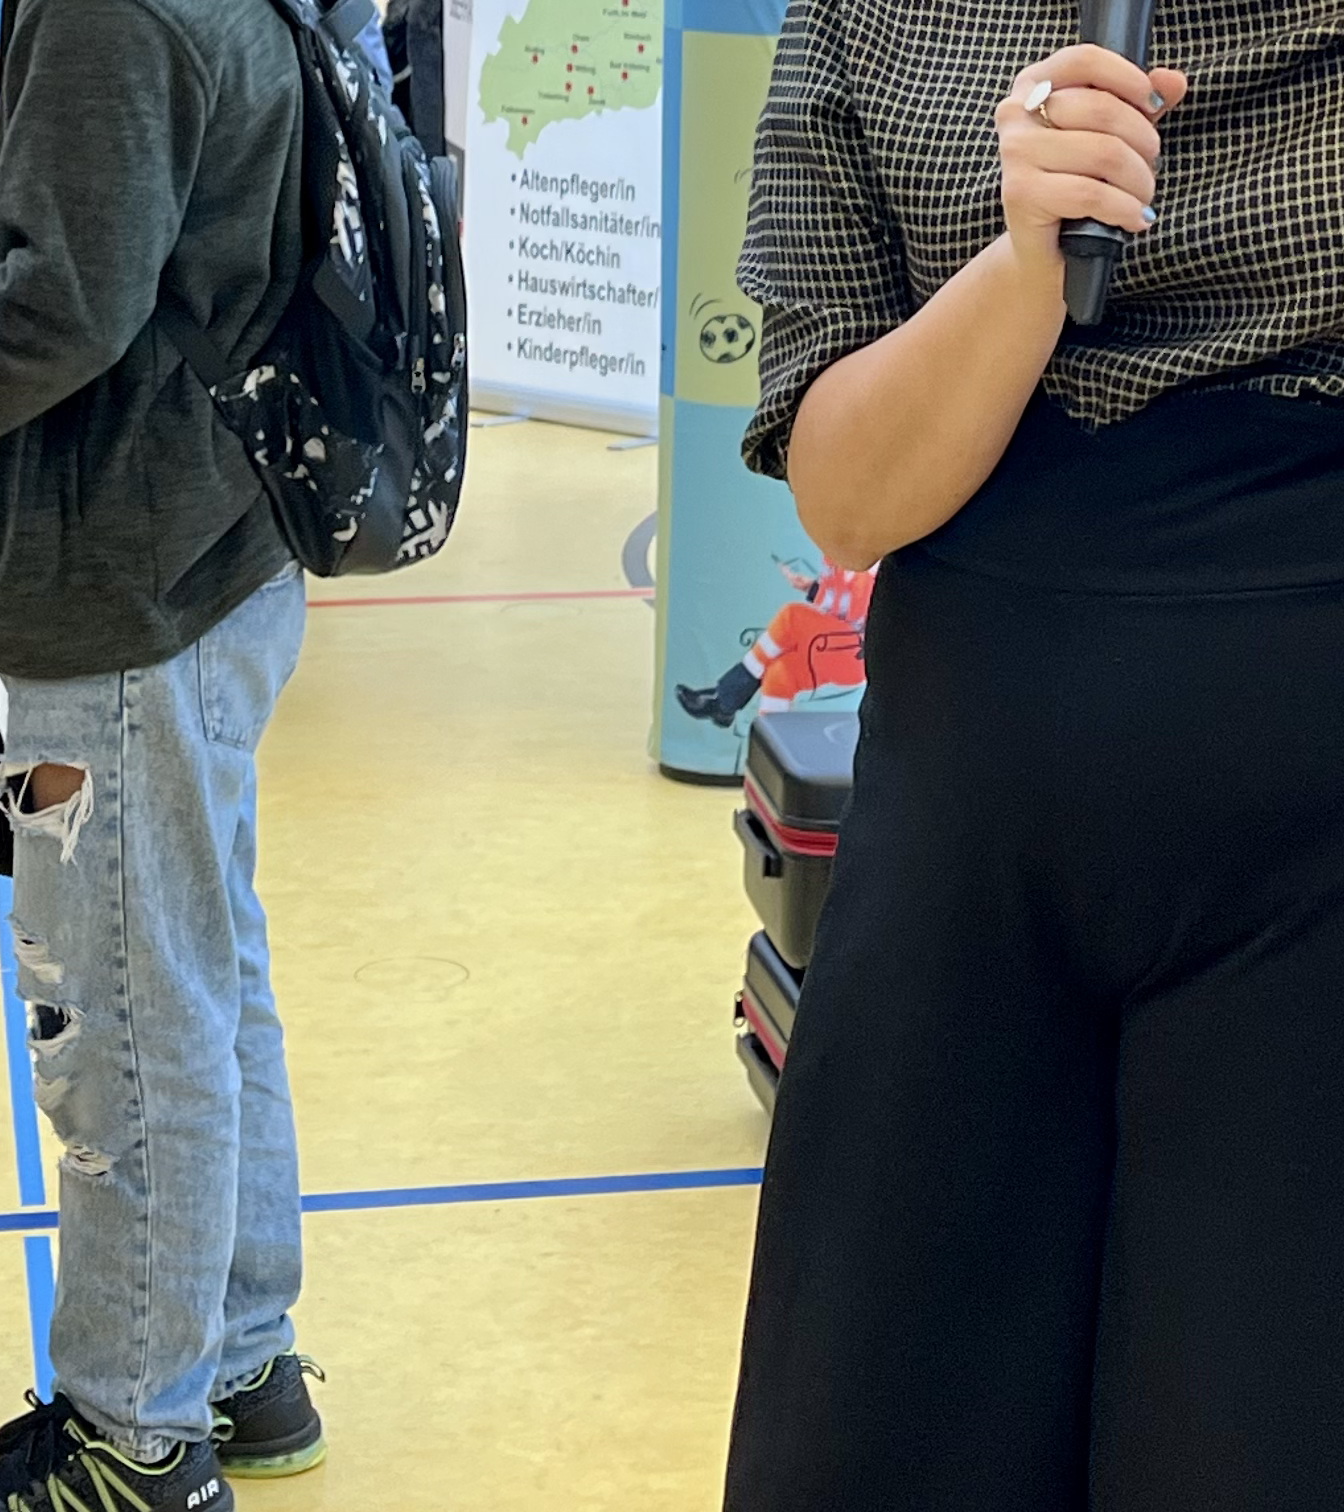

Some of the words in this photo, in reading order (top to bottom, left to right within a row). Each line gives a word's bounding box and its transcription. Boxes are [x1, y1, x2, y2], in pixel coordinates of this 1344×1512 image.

[519, 168, 636, 203] Altenpfleger/in
[519, 202, 661, 238] Notfallsanitäter/in
[518, 236, 621, 269] Koch/Köchin
[517, 269, 659, 308] Hauswirtschafter/
[517, 303, 602, 335] Erzieher/in
[517, 337, 646, 377] Kinderpfleger/in
[187, 1478, 220, 1510] AIR
